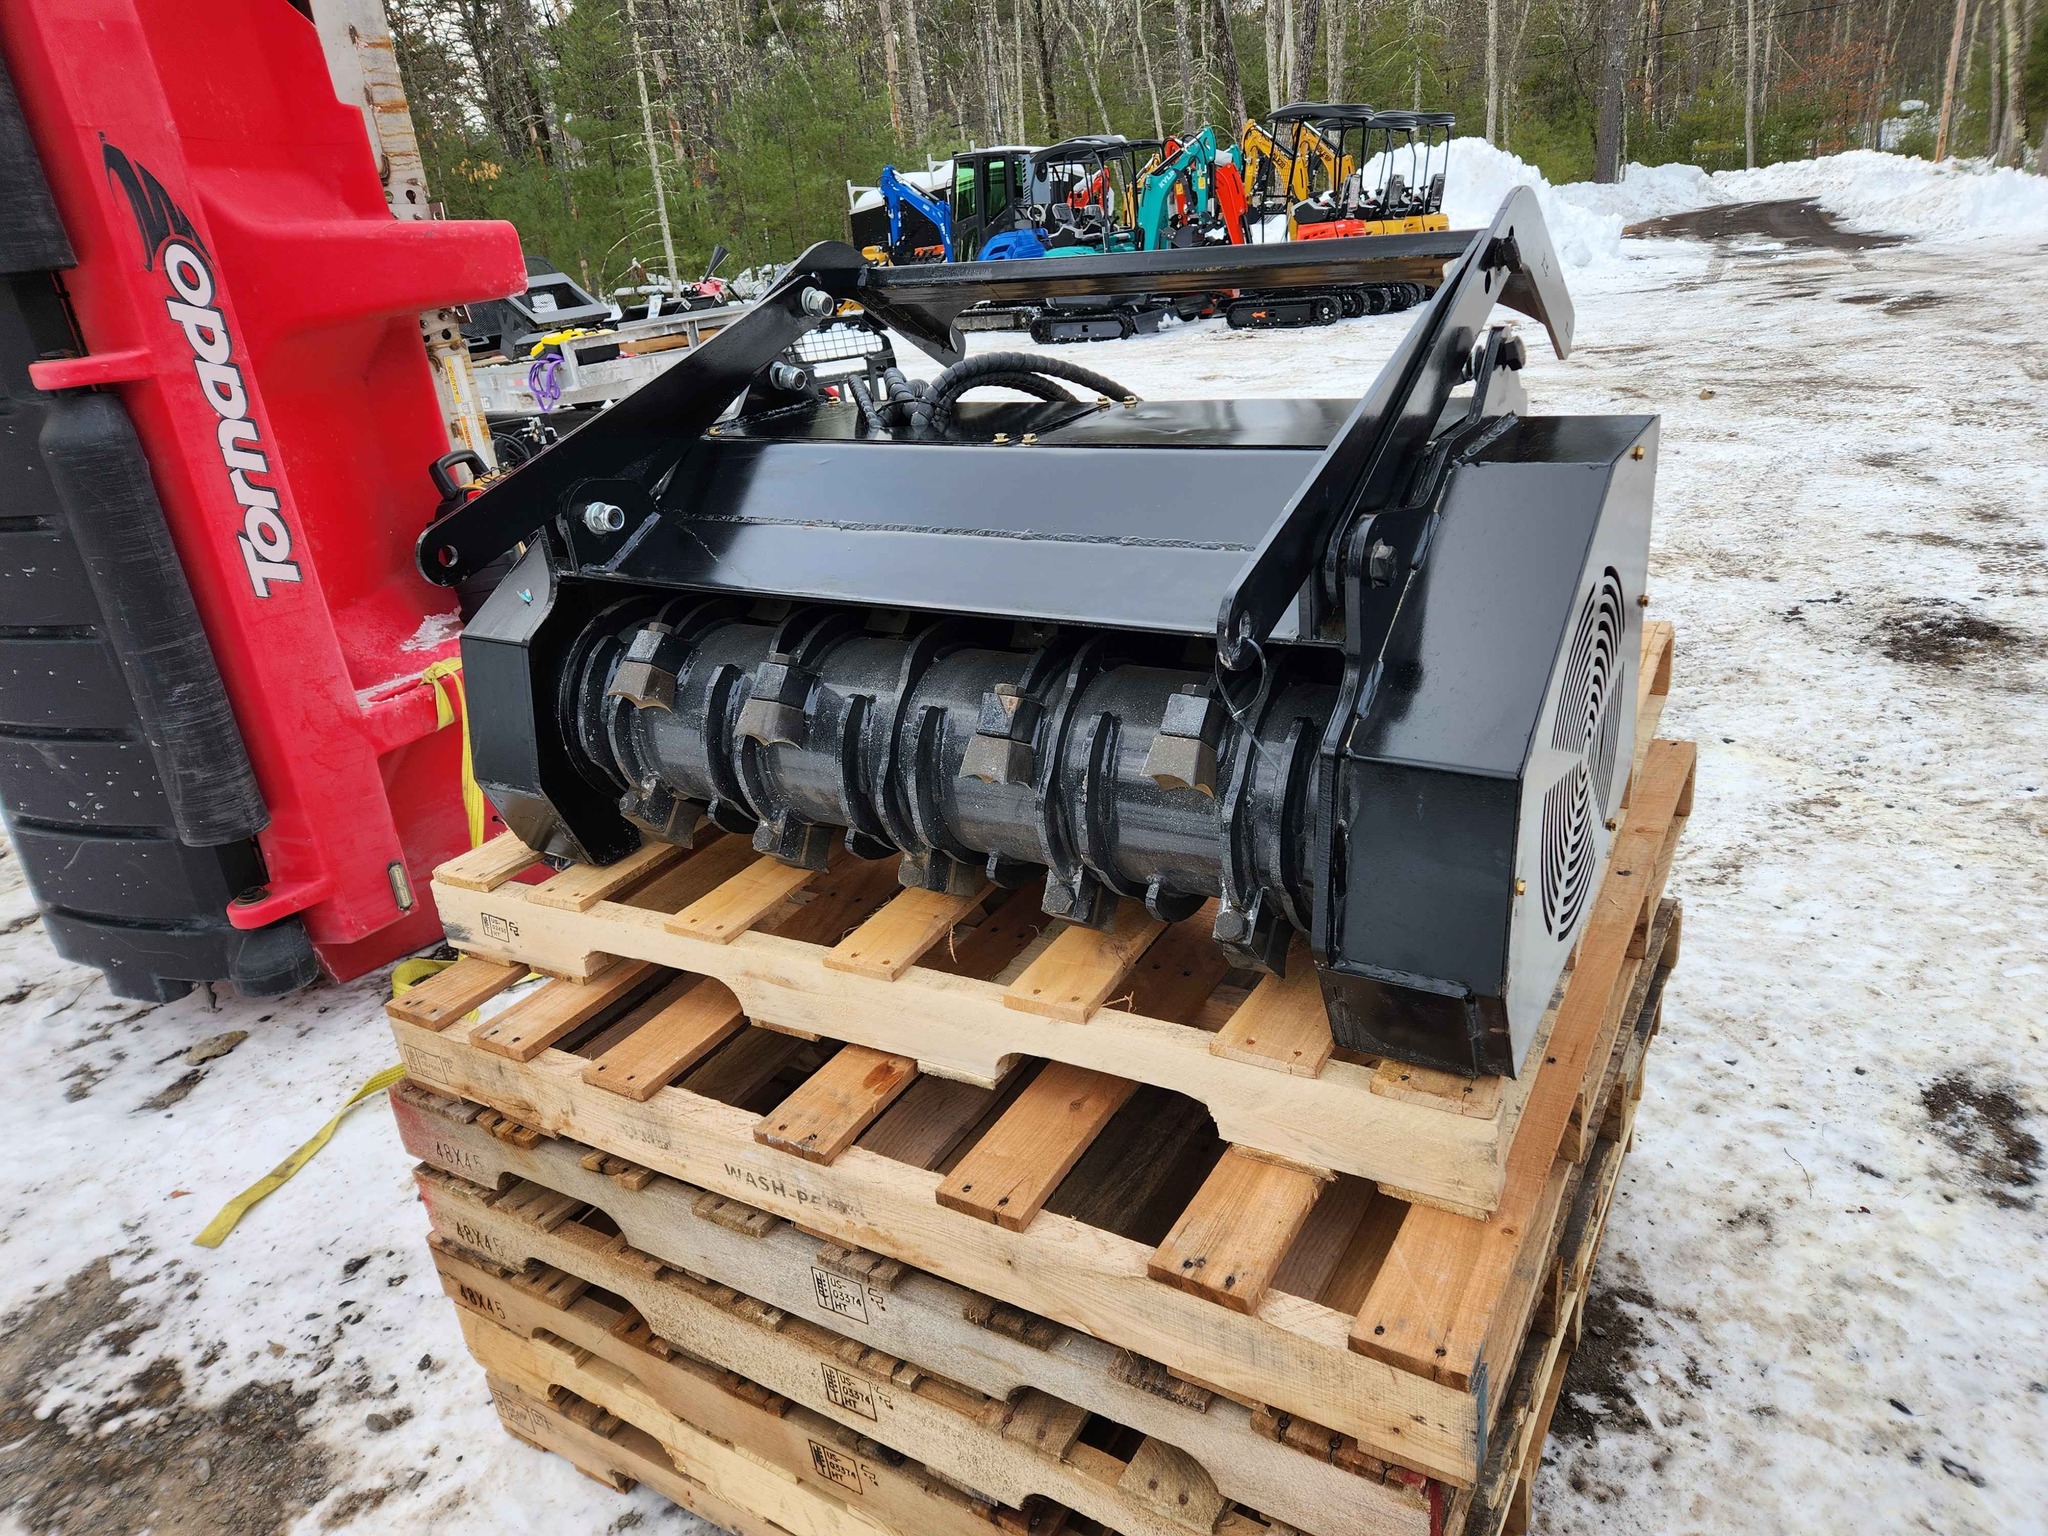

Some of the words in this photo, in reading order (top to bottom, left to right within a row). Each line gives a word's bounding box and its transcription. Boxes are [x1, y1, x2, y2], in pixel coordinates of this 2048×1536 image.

[448, 366, 458, 391] CAUTION
[164, 238, 302, 599] Tornado
[457, 1222, 504, 1256] 48X45
[830, 1278, 847, 1289] US-
[460, 1284, 505, 1319] 48X45
[833, 1290, 862, 1307] 03374
[835, 1301, 847, 1312] HT
[840, 1374, 856, 1386] US-
[842, 1386, 871, 1405] 03374
[844, 1397, 857, 1409] HT
[826, 1451, 841, 1463] US-
[829, 1461, 856, 1480] 03374
[831, 1471, 843, 1482] HT
